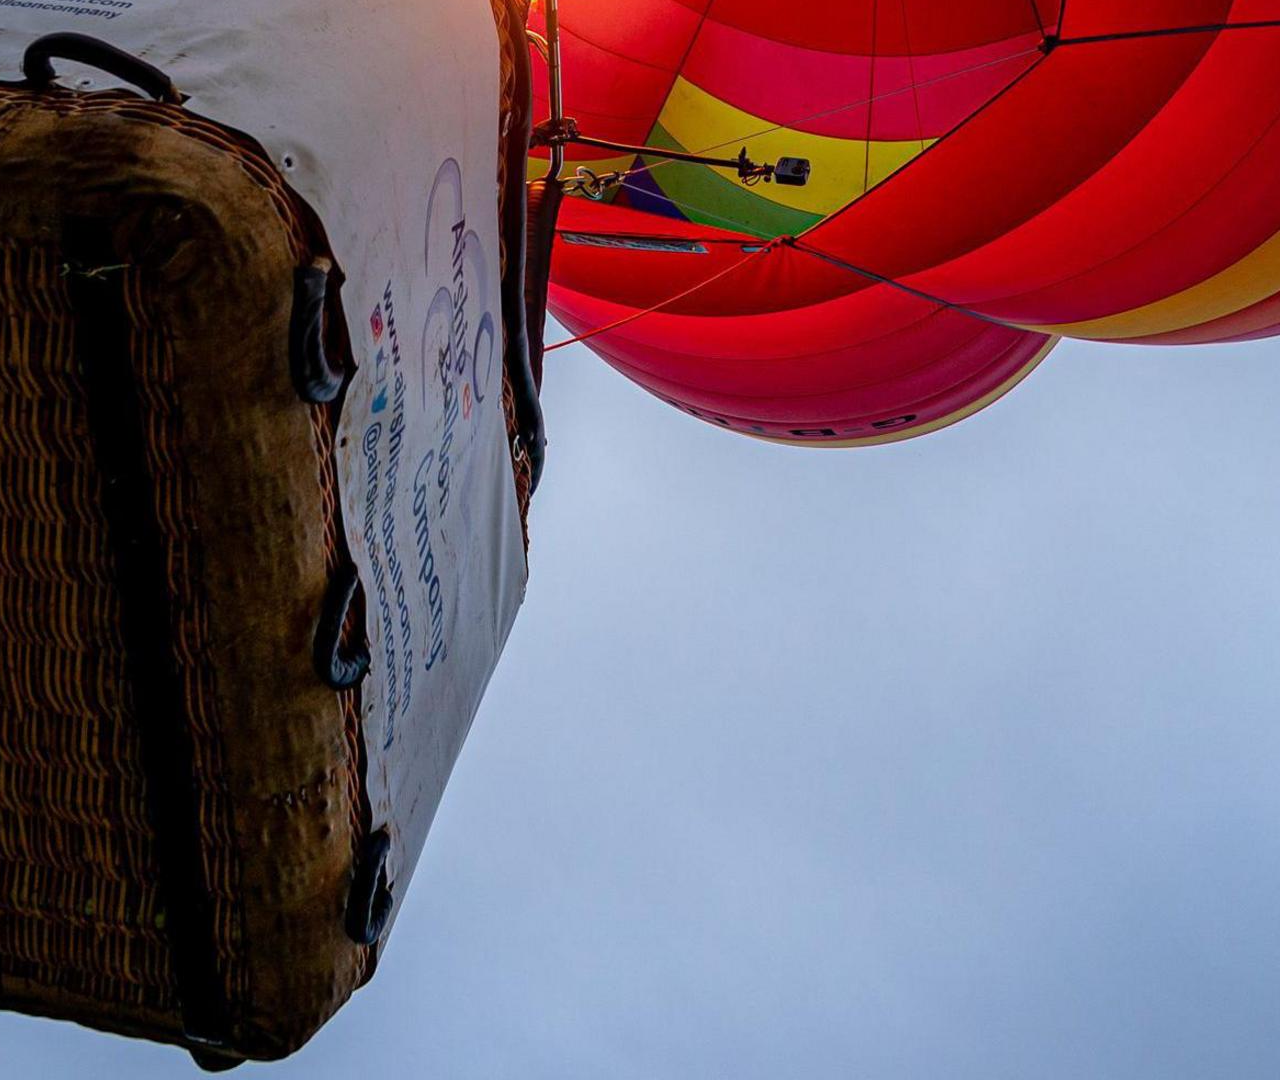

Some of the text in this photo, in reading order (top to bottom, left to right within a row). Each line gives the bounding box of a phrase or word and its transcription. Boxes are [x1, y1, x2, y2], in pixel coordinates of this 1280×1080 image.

[451, 218, 468, 375] Airship
[381, 279, 414, 716] www.airshipandballoon.com
[438, 341, 459, 519] Balloon
[362, 421, 395, 751] @airshipballooncompany
